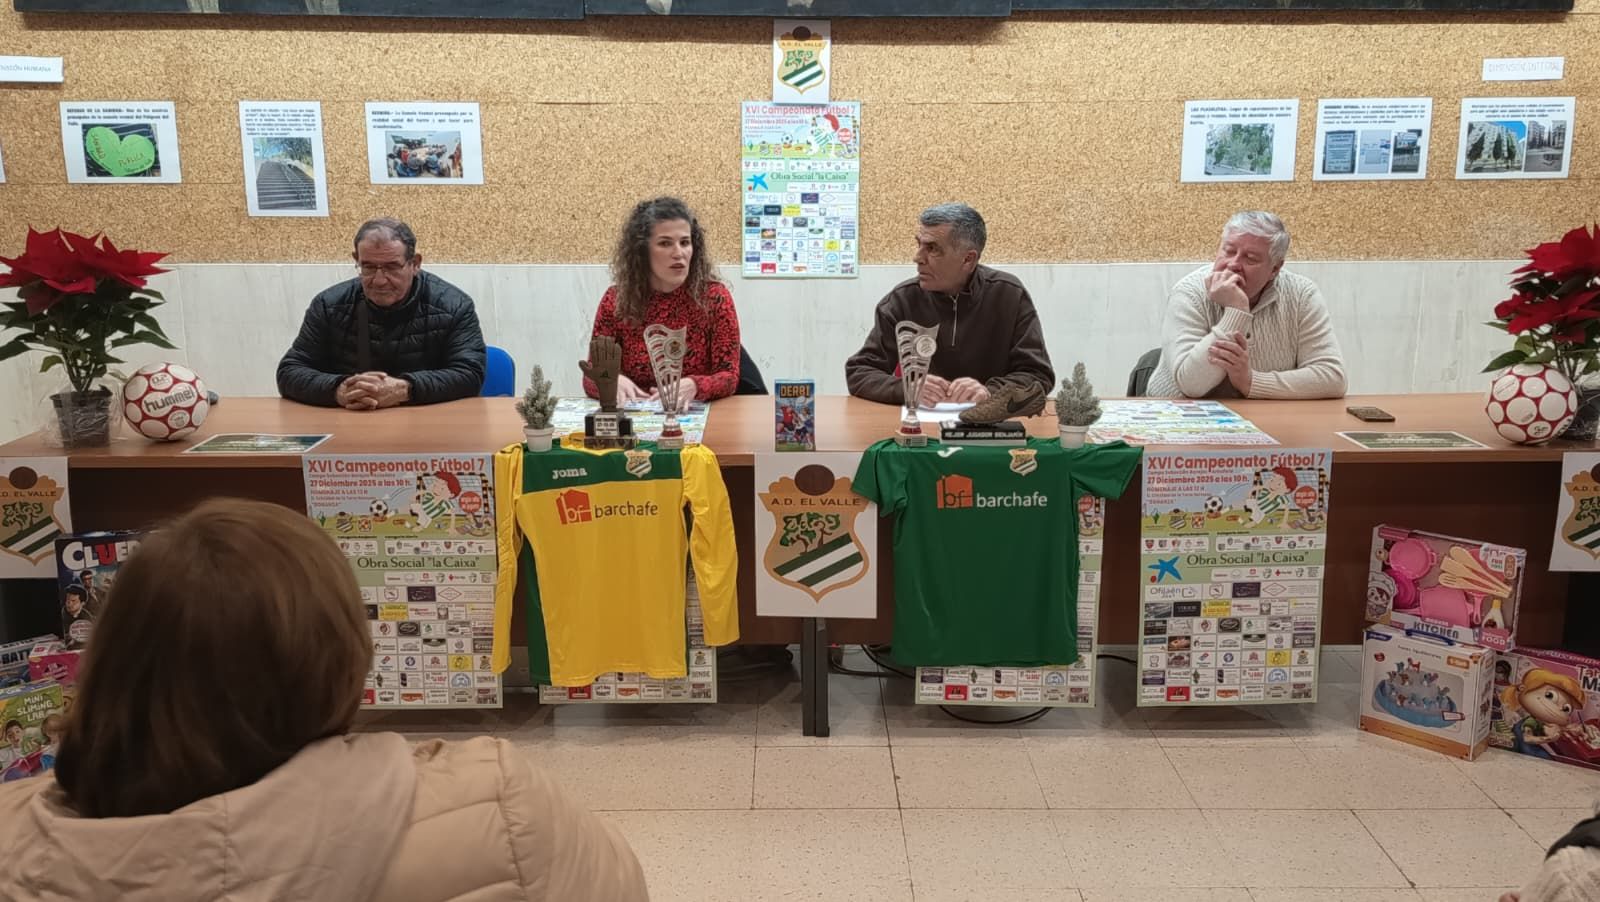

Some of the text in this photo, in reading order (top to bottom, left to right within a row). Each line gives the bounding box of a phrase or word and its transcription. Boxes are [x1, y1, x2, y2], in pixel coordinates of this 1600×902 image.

[144, 385, 195, 413] hummel
[308, 457, 485, 476] XVI Campeonato Fútbol 7
[1148, 452, 1326, 472] XVI Campeonato Fútbol 7
[319, 479, 357, 487] Diciembre
[359, 479, 377, 487] 2025
[384, 479, 395, 487] las
[1147, 476, 1155, 484] 27
[1156, 475, 1196, 484] Diciembre
[1196, 475, 1214, 483] 2025
[771, 497, 861, 506] A.D. EL VALLE
[976, 491, 1048, 508] barchafe
[594, 500, 658, 518] barchafe
[357, 556, 480, 568] Obra Social "la Caixa"
[1186, 551, 1309, 566] Obra Social "la Caixa"
[1413, 621, 1459, 640] KITCHEN
